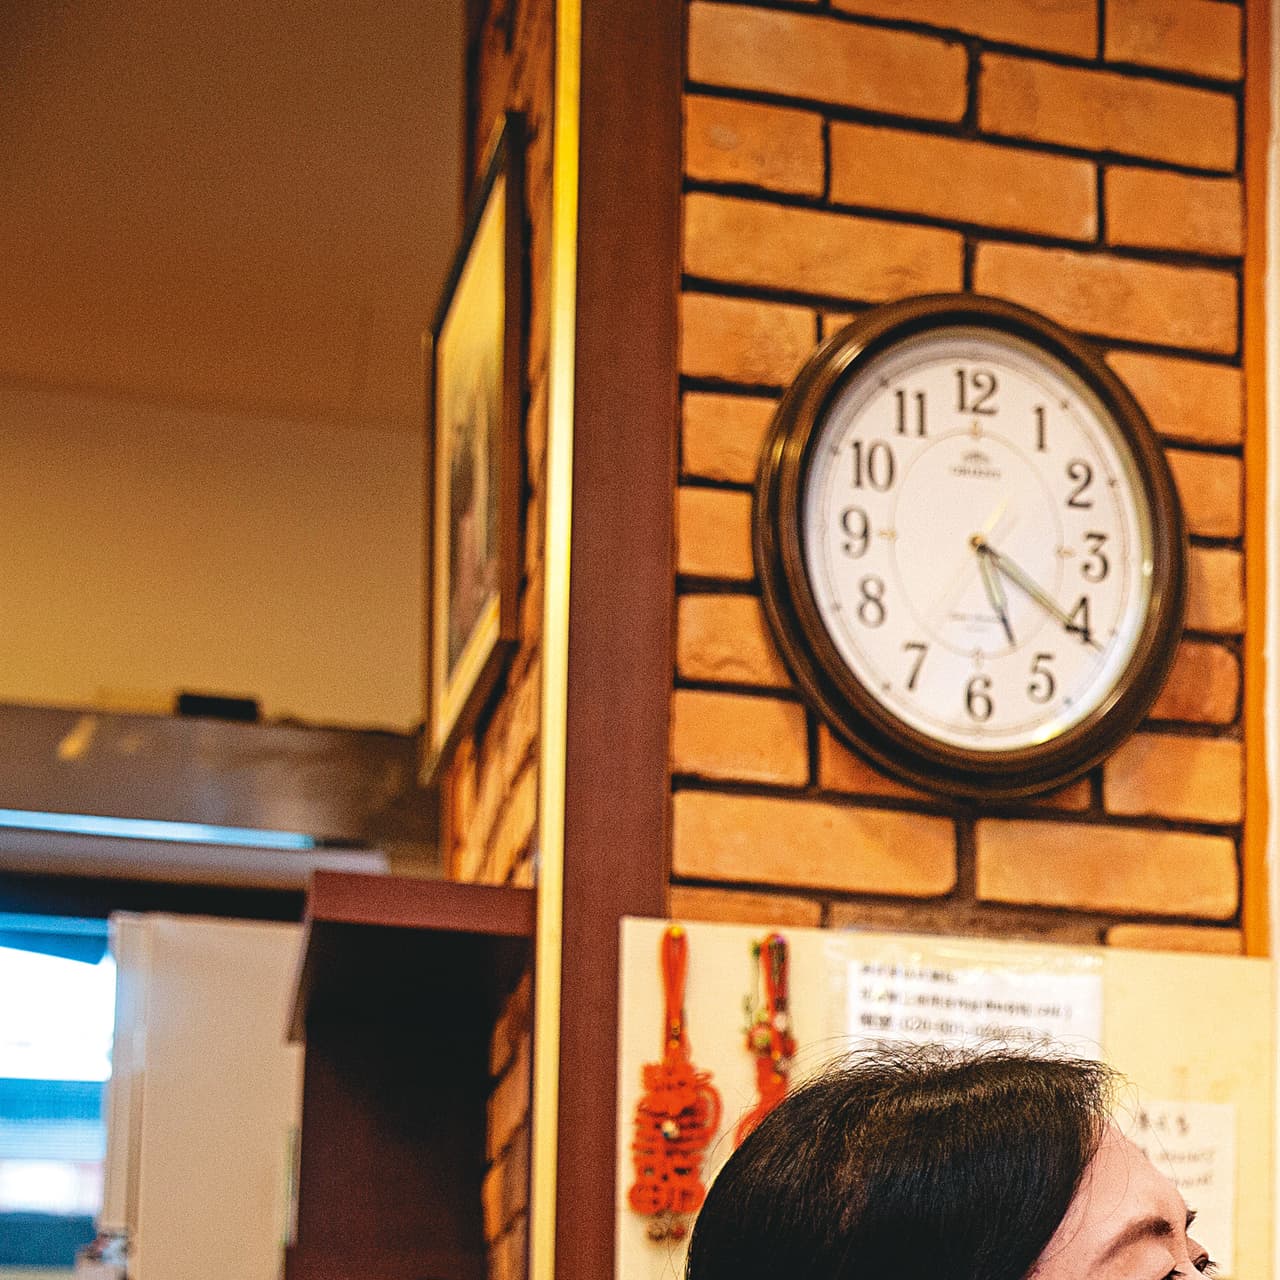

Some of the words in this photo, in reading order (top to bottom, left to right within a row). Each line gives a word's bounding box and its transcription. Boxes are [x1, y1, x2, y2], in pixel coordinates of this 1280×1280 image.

[895, 390, 927, 437] 11
[955, 368, 997, 416] 12
[1033, 406, 1047, 451] 1
[851, 440, 896, 491] 10
[1067, 457, 1093, 509] 2
[840, 505, 870, 559] 9
[1080, 532, 1110, 583] 3
[856, 574, 887, 629] 8
[1066, 596, 1091, 644] 4
[903, 642, 929, 691] 7
[1027, 653, 1056, 703] 5
[963, 673, 993, 723] 6
